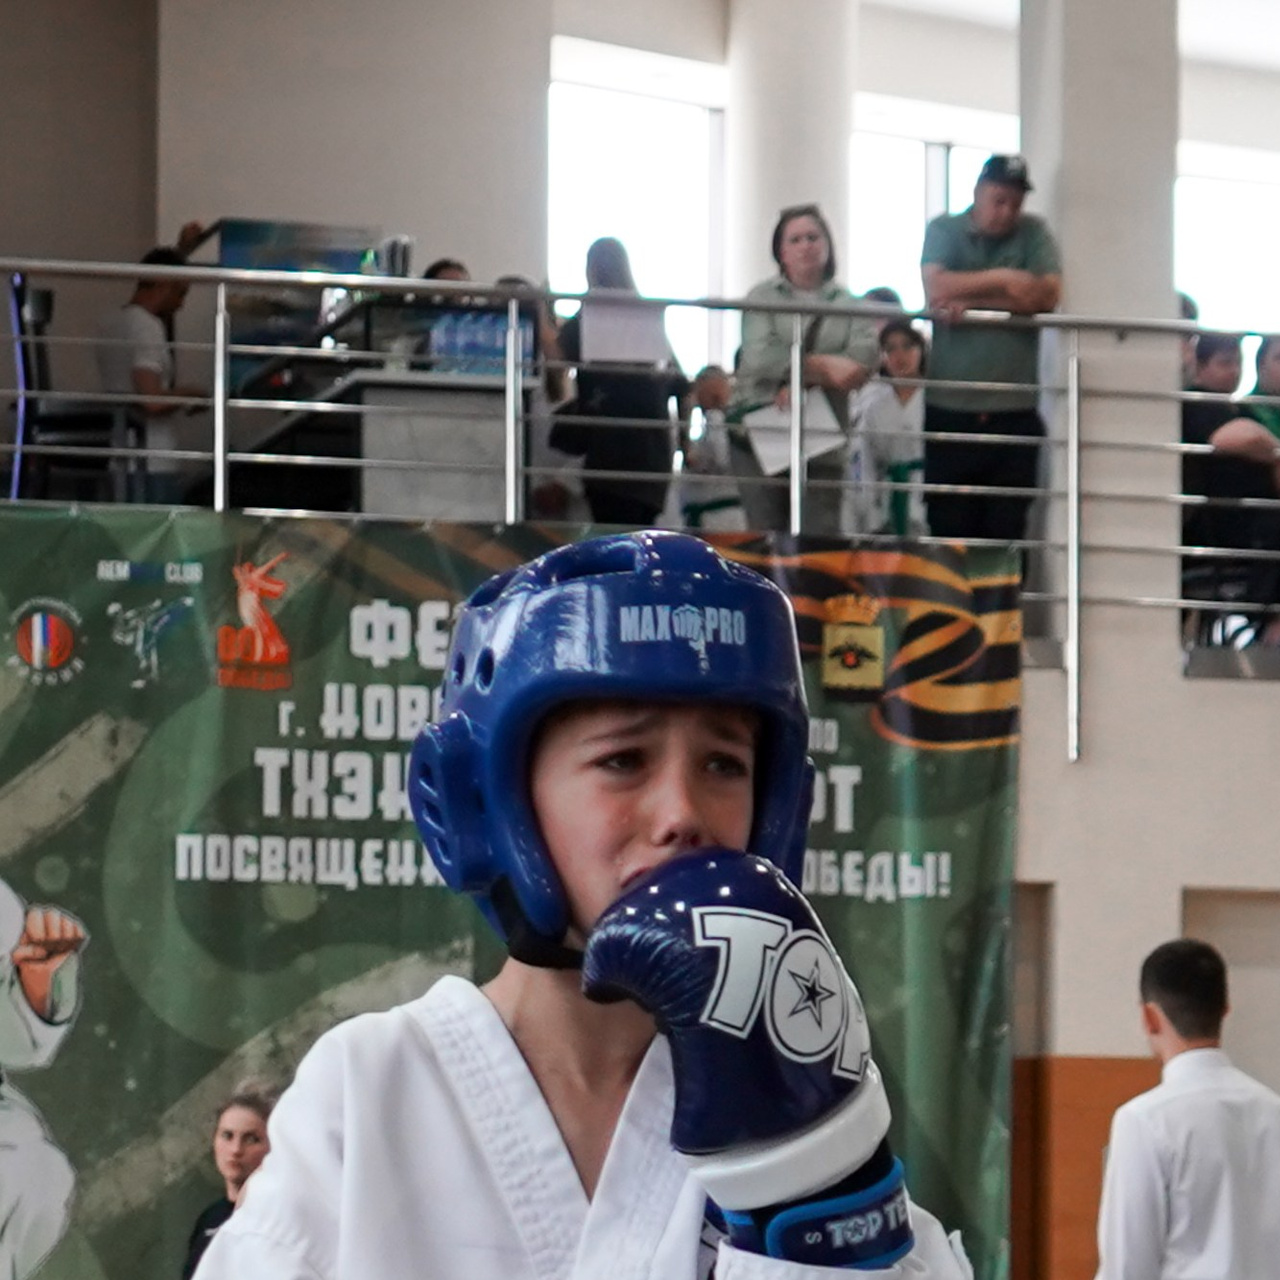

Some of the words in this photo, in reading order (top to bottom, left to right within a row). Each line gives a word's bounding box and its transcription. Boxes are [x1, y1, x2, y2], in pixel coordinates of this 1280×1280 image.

[350, 599, 456, 669] ФЕ
[620, 606, 672, 642] MAX
[704, 606, 747, 646] PRO
[319, 682, 444, 742] НОВ
[825, 1209, 884, 1250] TOP
